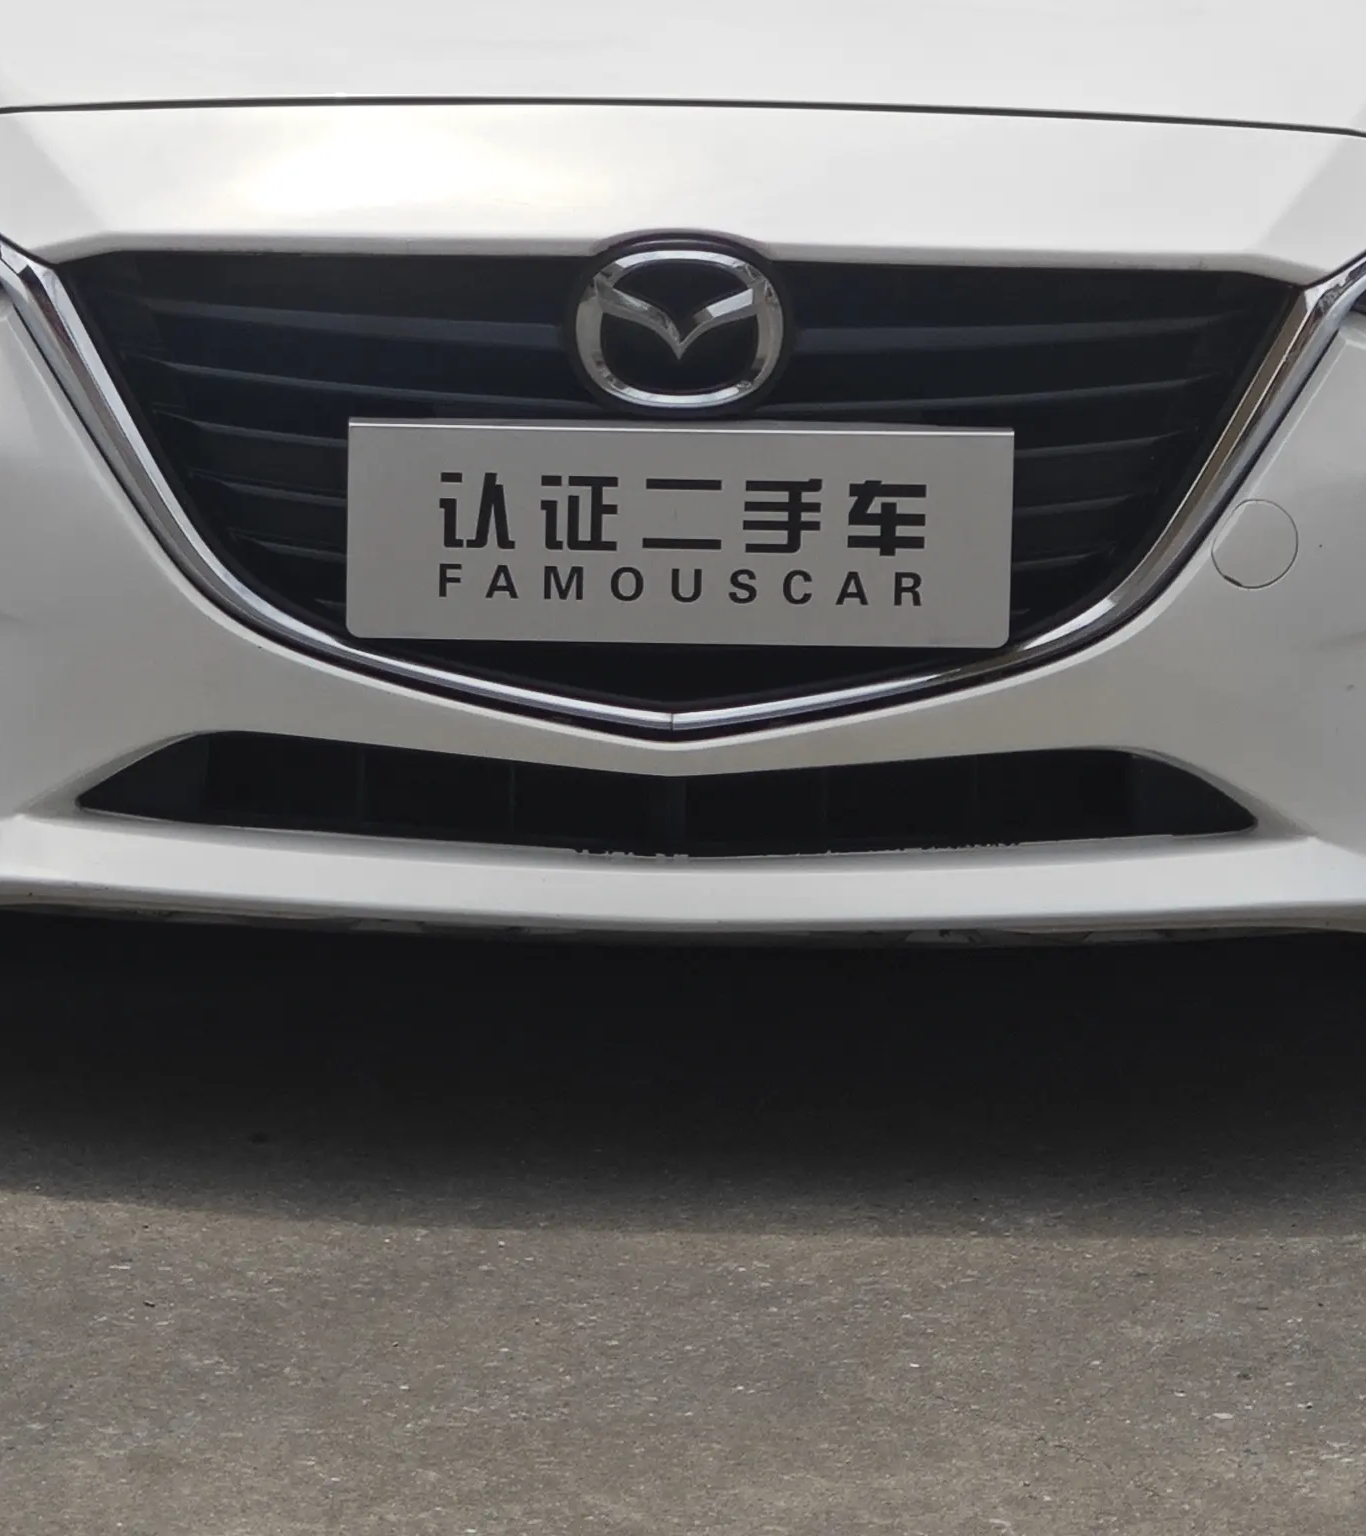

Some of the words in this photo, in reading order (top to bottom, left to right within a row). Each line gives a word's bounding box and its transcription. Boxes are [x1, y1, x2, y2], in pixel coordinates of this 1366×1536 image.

[439, 471, 928, 557] 认证二手车
[438, 563, 924, 607] FAMOUSCAR
